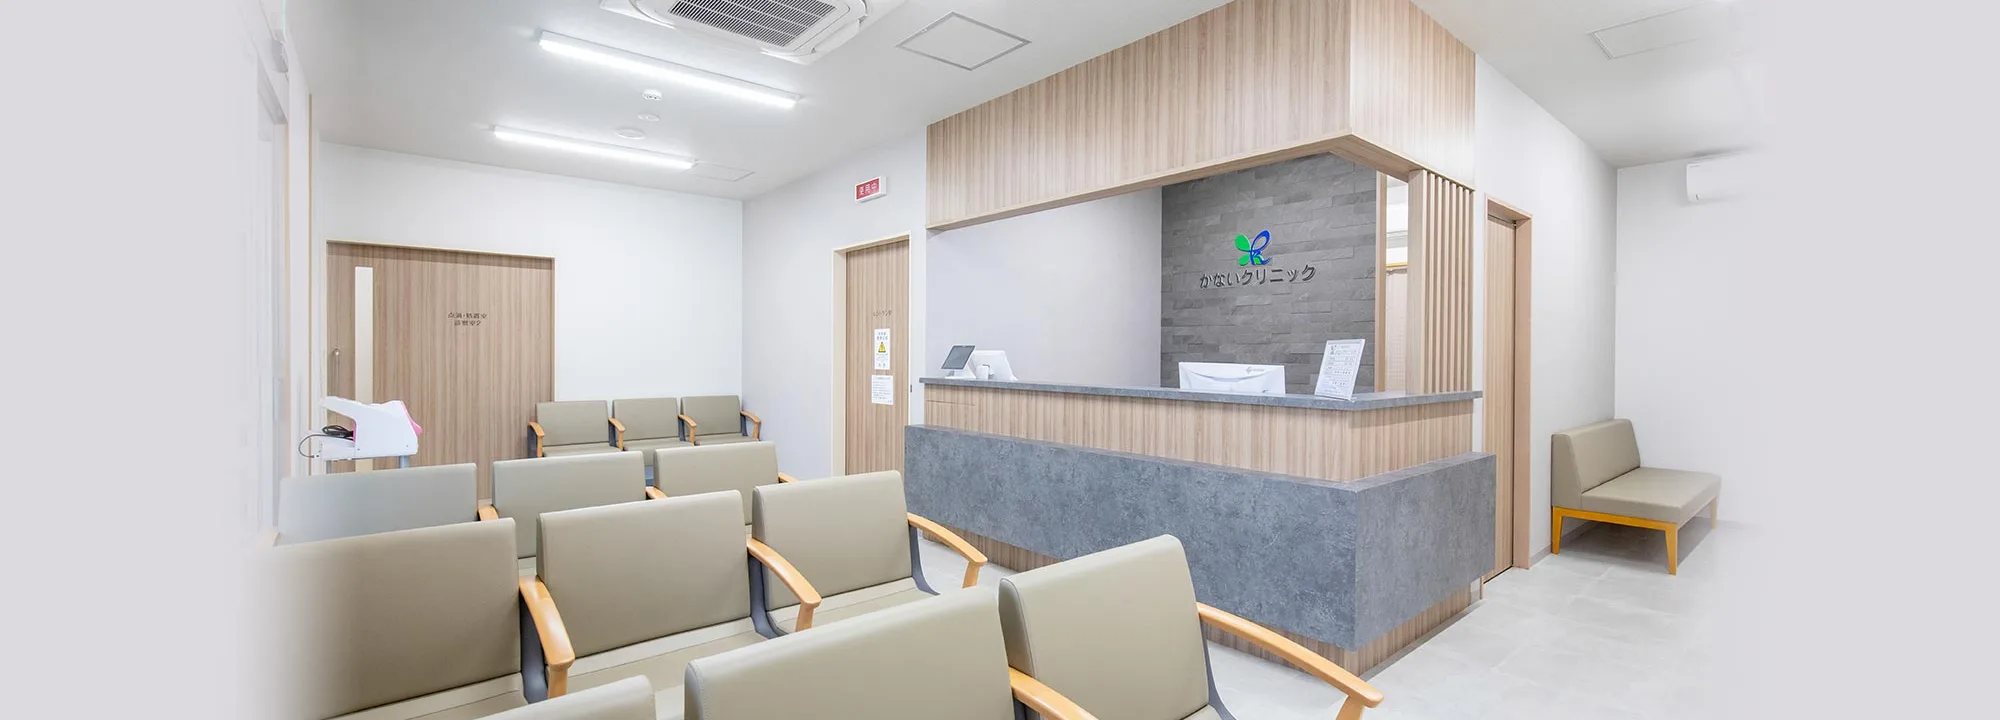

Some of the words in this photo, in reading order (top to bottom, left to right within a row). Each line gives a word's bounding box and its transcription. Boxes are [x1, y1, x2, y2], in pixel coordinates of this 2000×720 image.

[1199, 264, 1317, 289] かないクリニック
